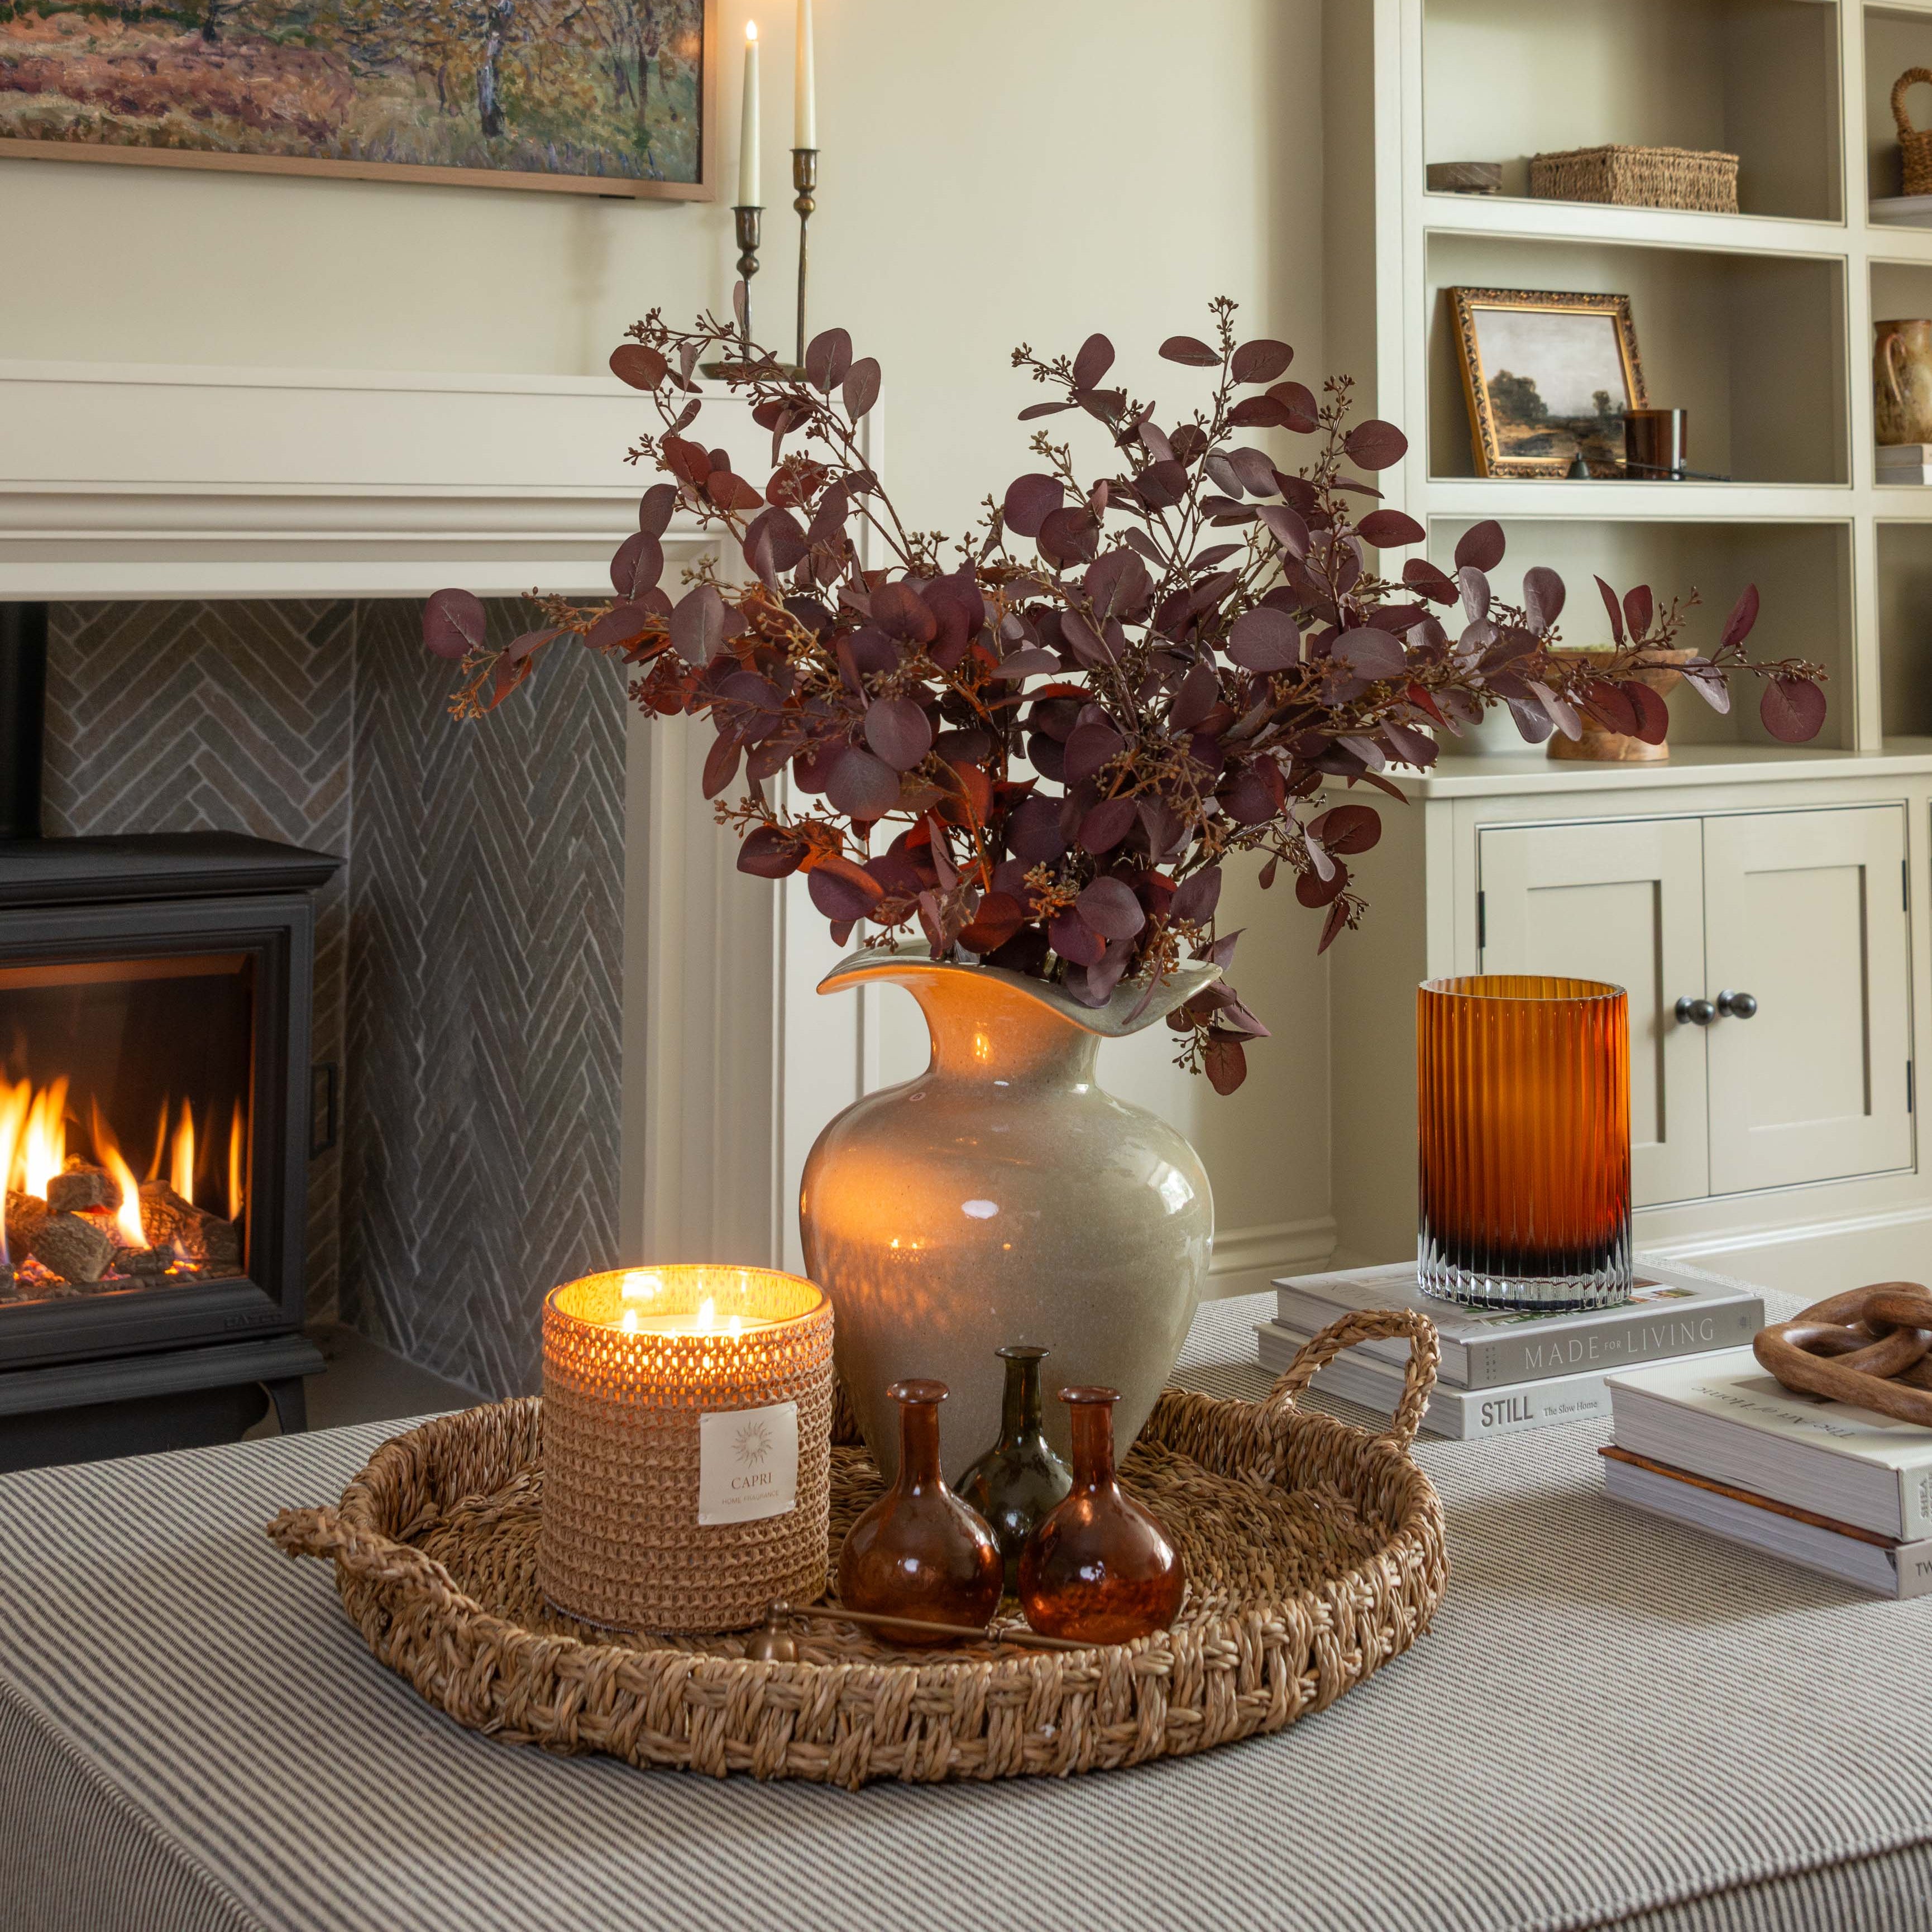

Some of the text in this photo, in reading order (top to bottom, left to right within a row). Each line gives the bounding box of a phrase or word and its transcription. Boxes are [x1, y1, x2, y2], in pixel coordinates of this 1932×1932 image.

[1525, 1336, 1599, 1369] MADE
[1604, 1340, 1622, 1351] FOR
[1627, 1318, 1714, 1353] LIVING
[1543, 1400, 1598, 1417] The Slow Home
[1691, 1386, 1755, 1410] Home
[1481, 1396, 1533, 1427] STILL
[1777, 1412, 1811, 1424] Art
[731, 1472, 772, 1490] CAPRI
